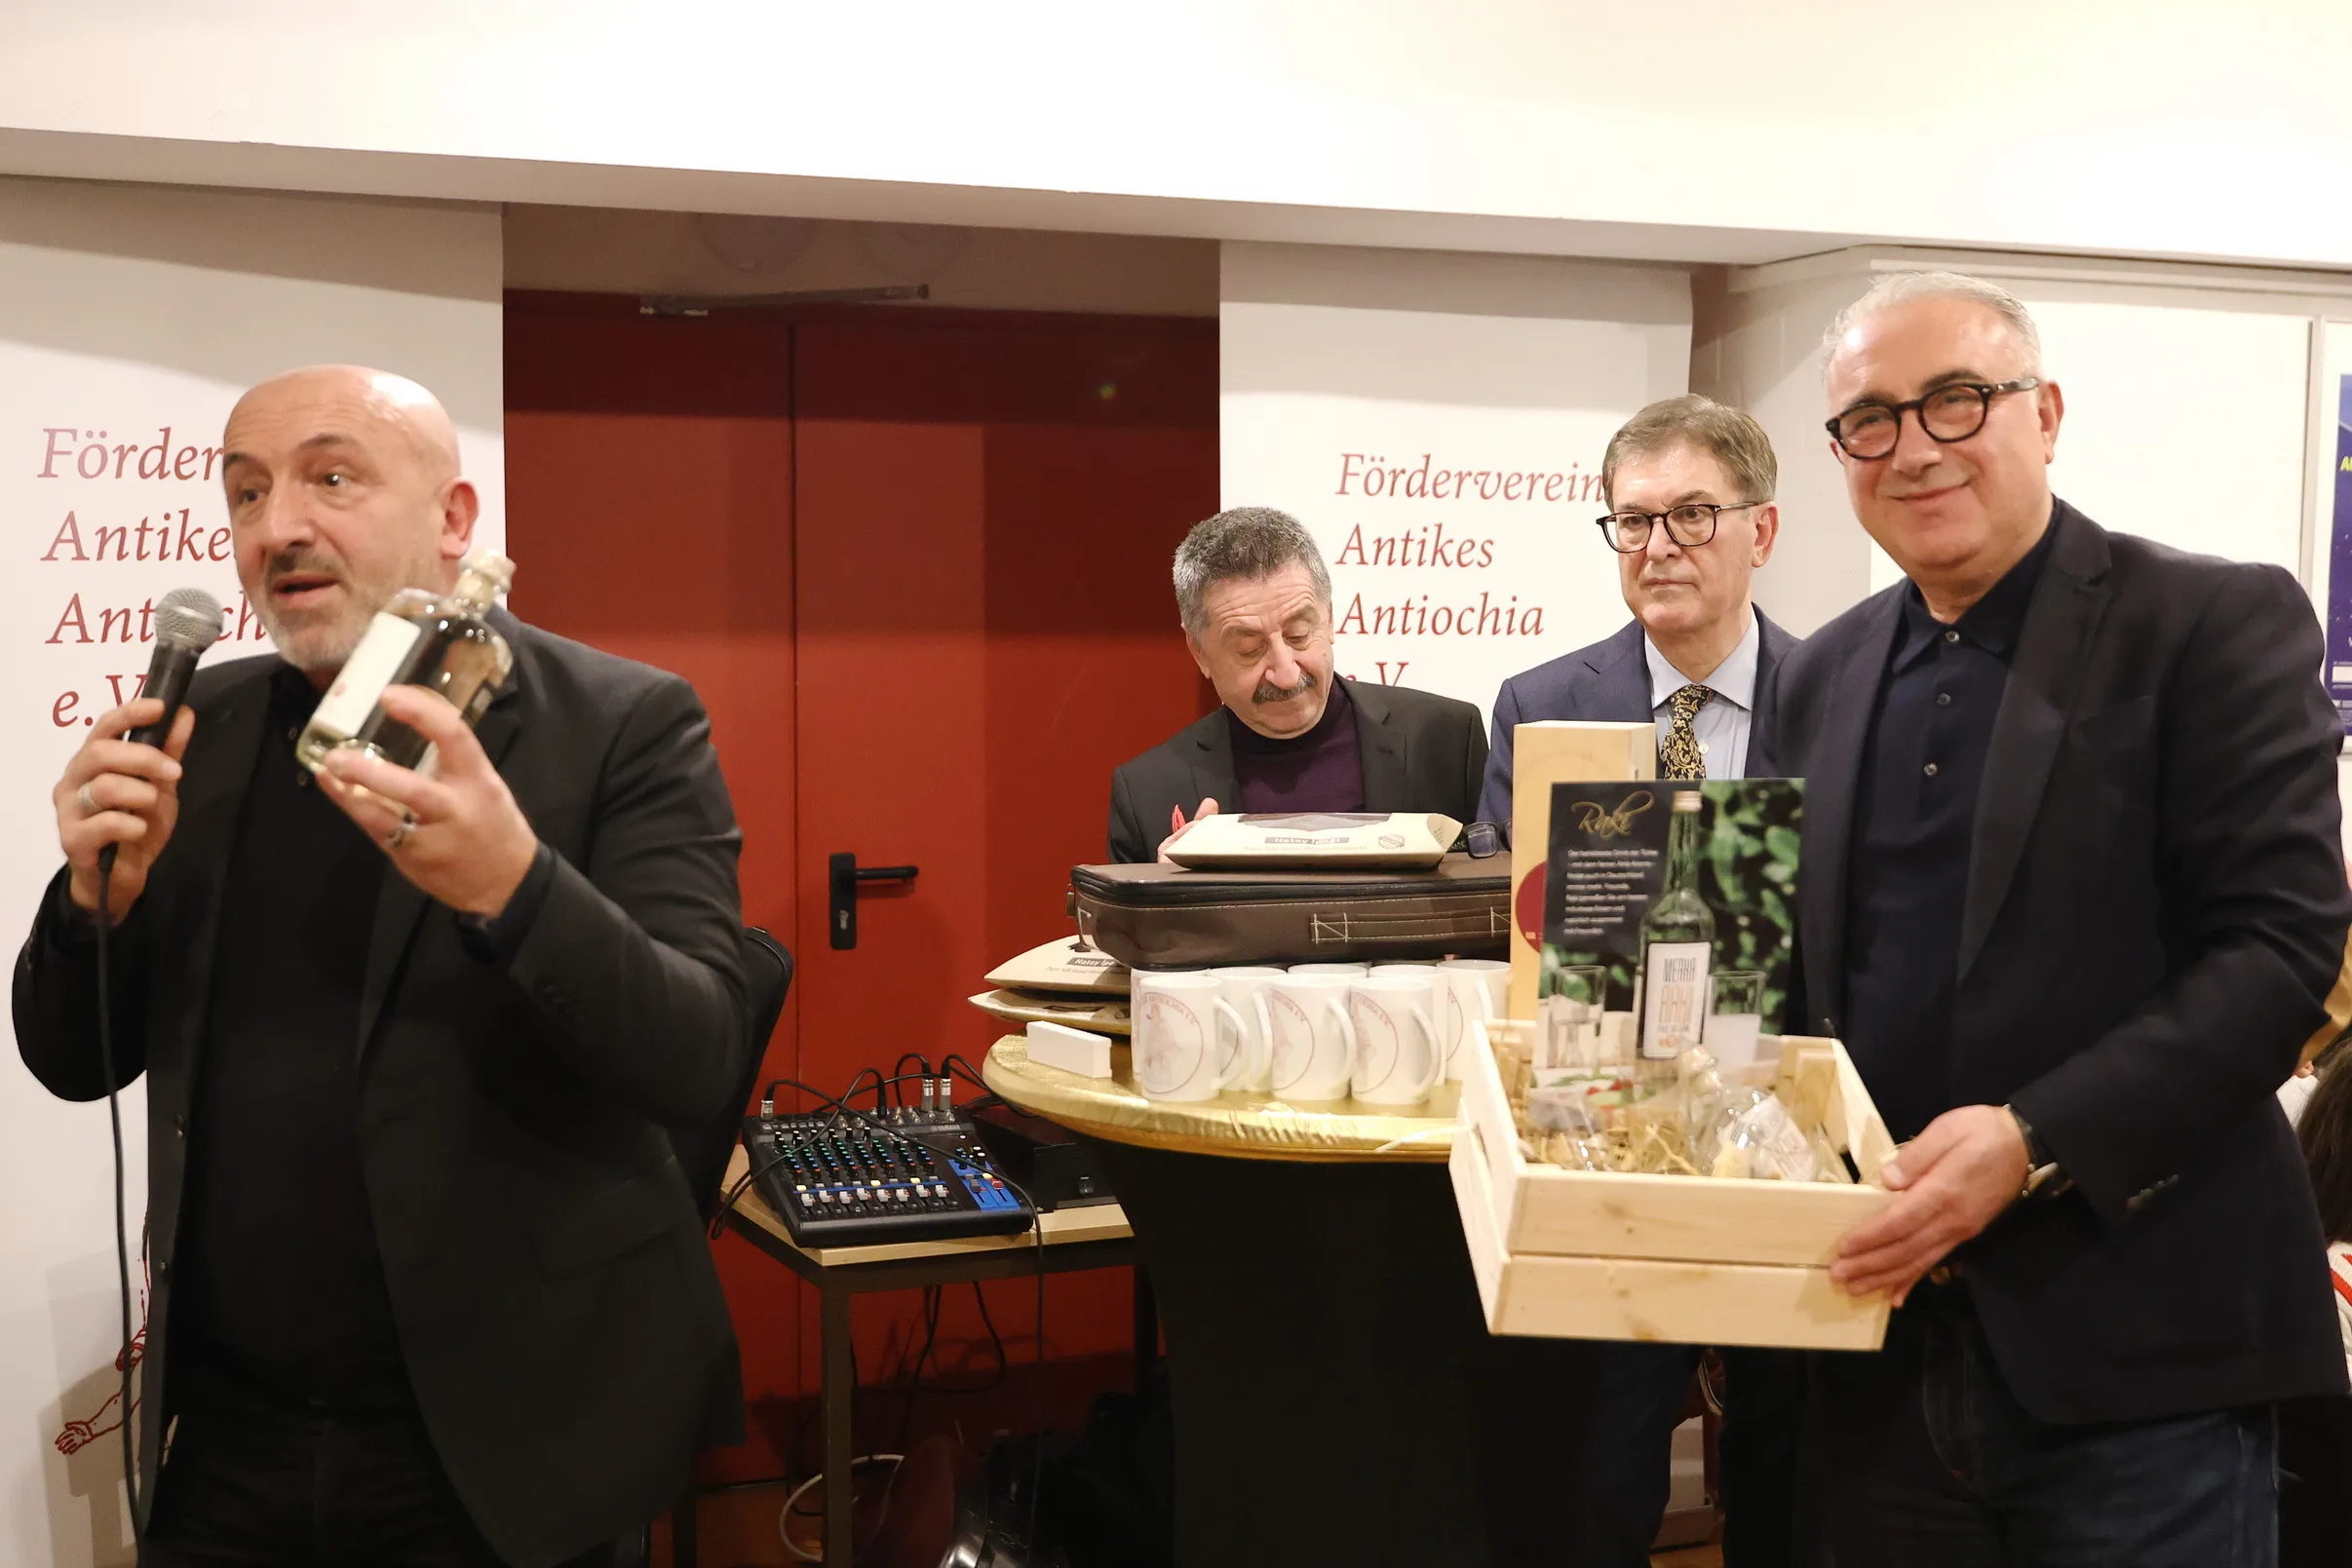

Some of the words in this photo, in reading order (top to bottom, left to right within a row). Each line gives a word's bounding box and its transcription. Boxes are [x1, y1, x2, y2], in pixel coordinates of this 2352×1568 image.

[37, 427, 223, 481] Förder
[1335, 452, 1603, 503] Förderverein
[40, 508, 237, 562] Antike
[1334, 522, 1494, 568] Antikes
[45, 591, 267, 645] Antch
[1335, 591, 1544, 636] Antiochia
[1074, 958, 1099, 967] Hatay
